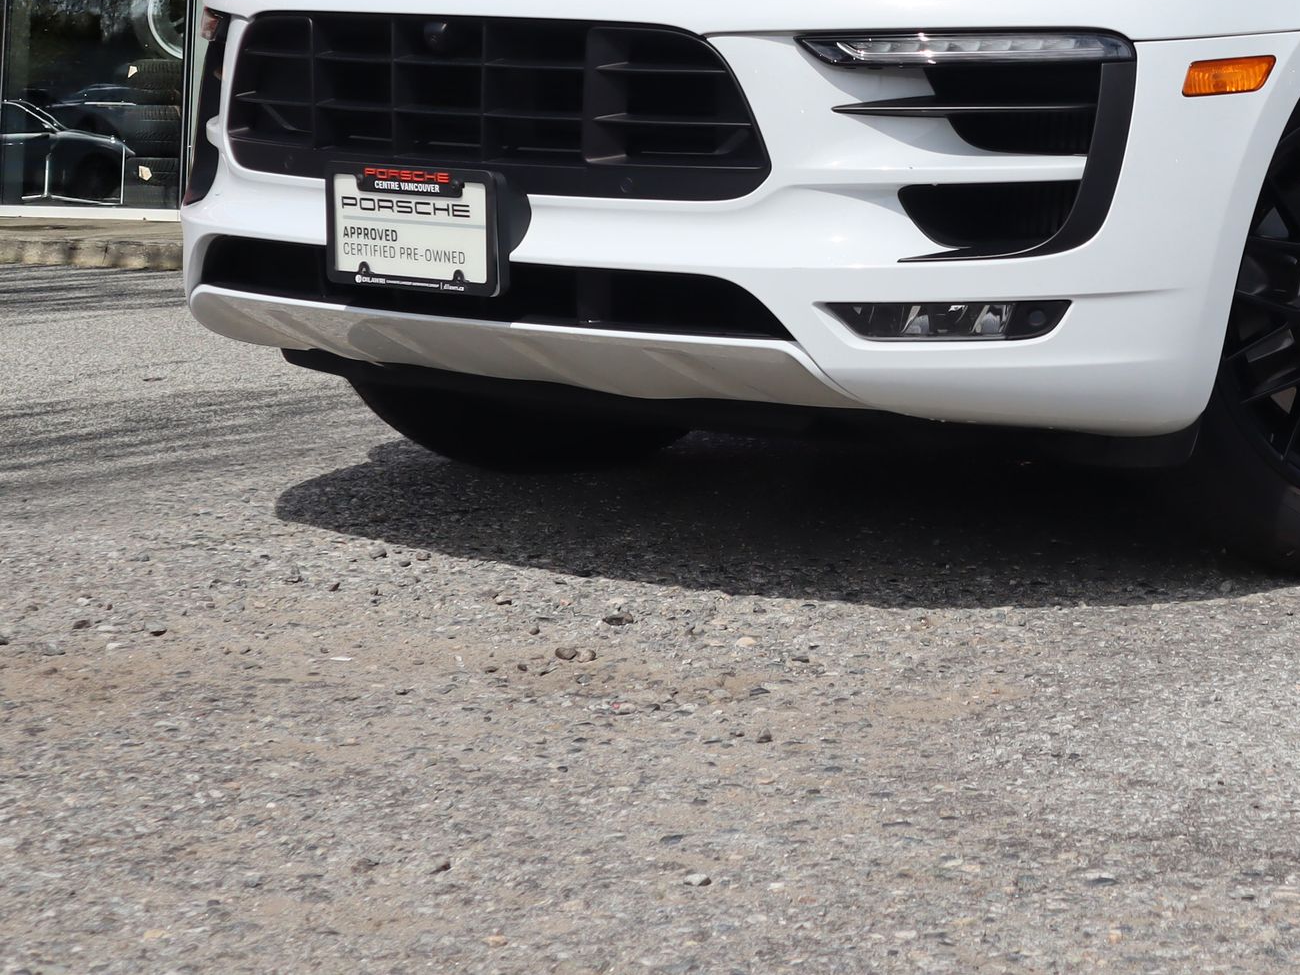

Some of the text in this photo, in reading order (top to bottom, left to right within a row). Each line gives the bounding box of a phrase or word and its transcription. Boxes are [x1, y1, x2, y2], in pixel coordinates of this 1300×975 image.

[364, 168, 450, 183] PORSCHE
[374, 180, 440, 193] CENTRE VANCOUVER
[341, 196, 471, 218] PORSCHE
[343, 226, 398, 242] APPROVED
[343, 242, 466, 265] CERTIFIED PRE-OWNED
